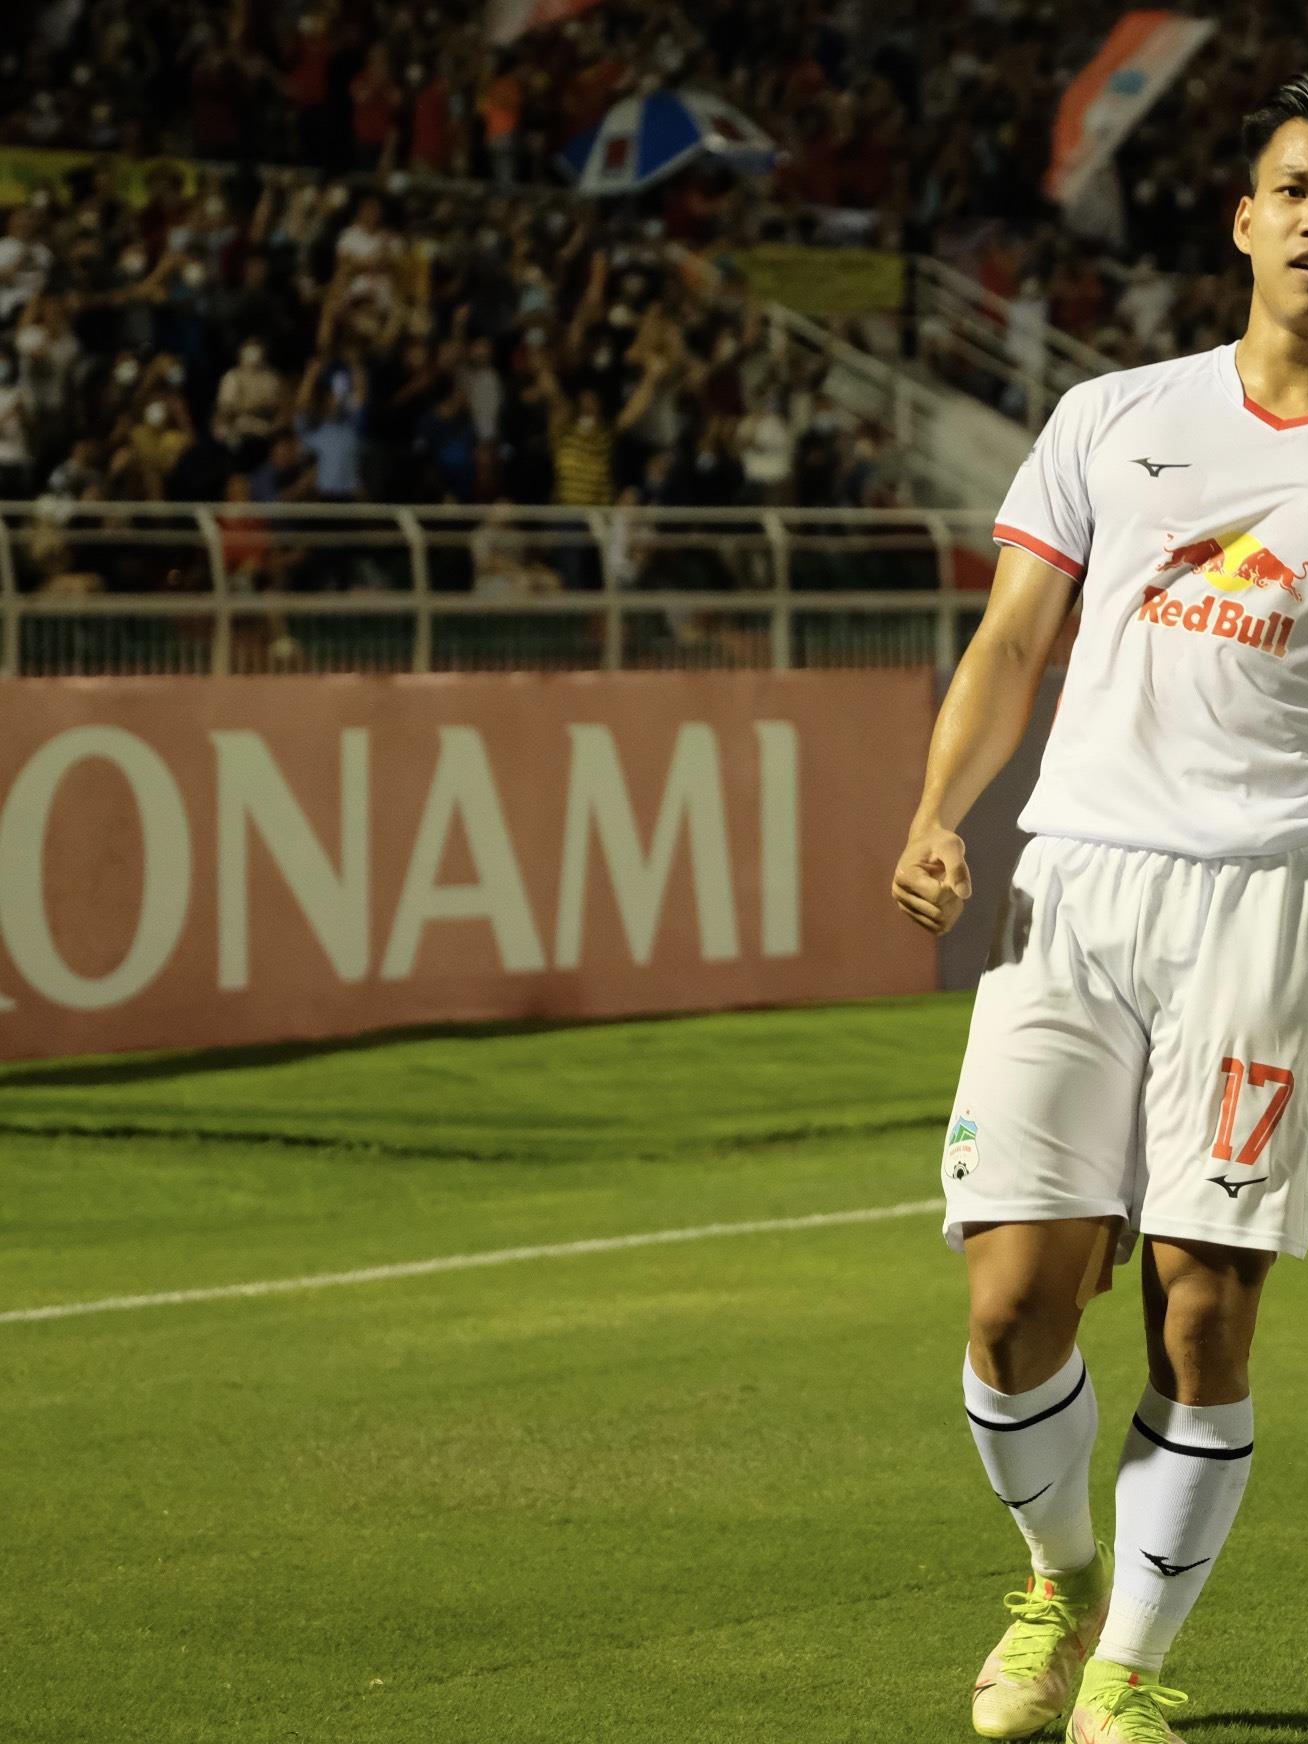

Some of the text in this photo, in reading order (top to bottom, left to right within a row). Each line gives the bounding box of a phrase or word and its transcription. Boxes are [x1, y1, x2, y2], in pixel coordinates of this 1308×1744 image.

[1137, 585, 1295, 658] Red Bull
[0, 720, 801, 1012] ONAMI
[1211, 1057, 1294, 1166] 17
